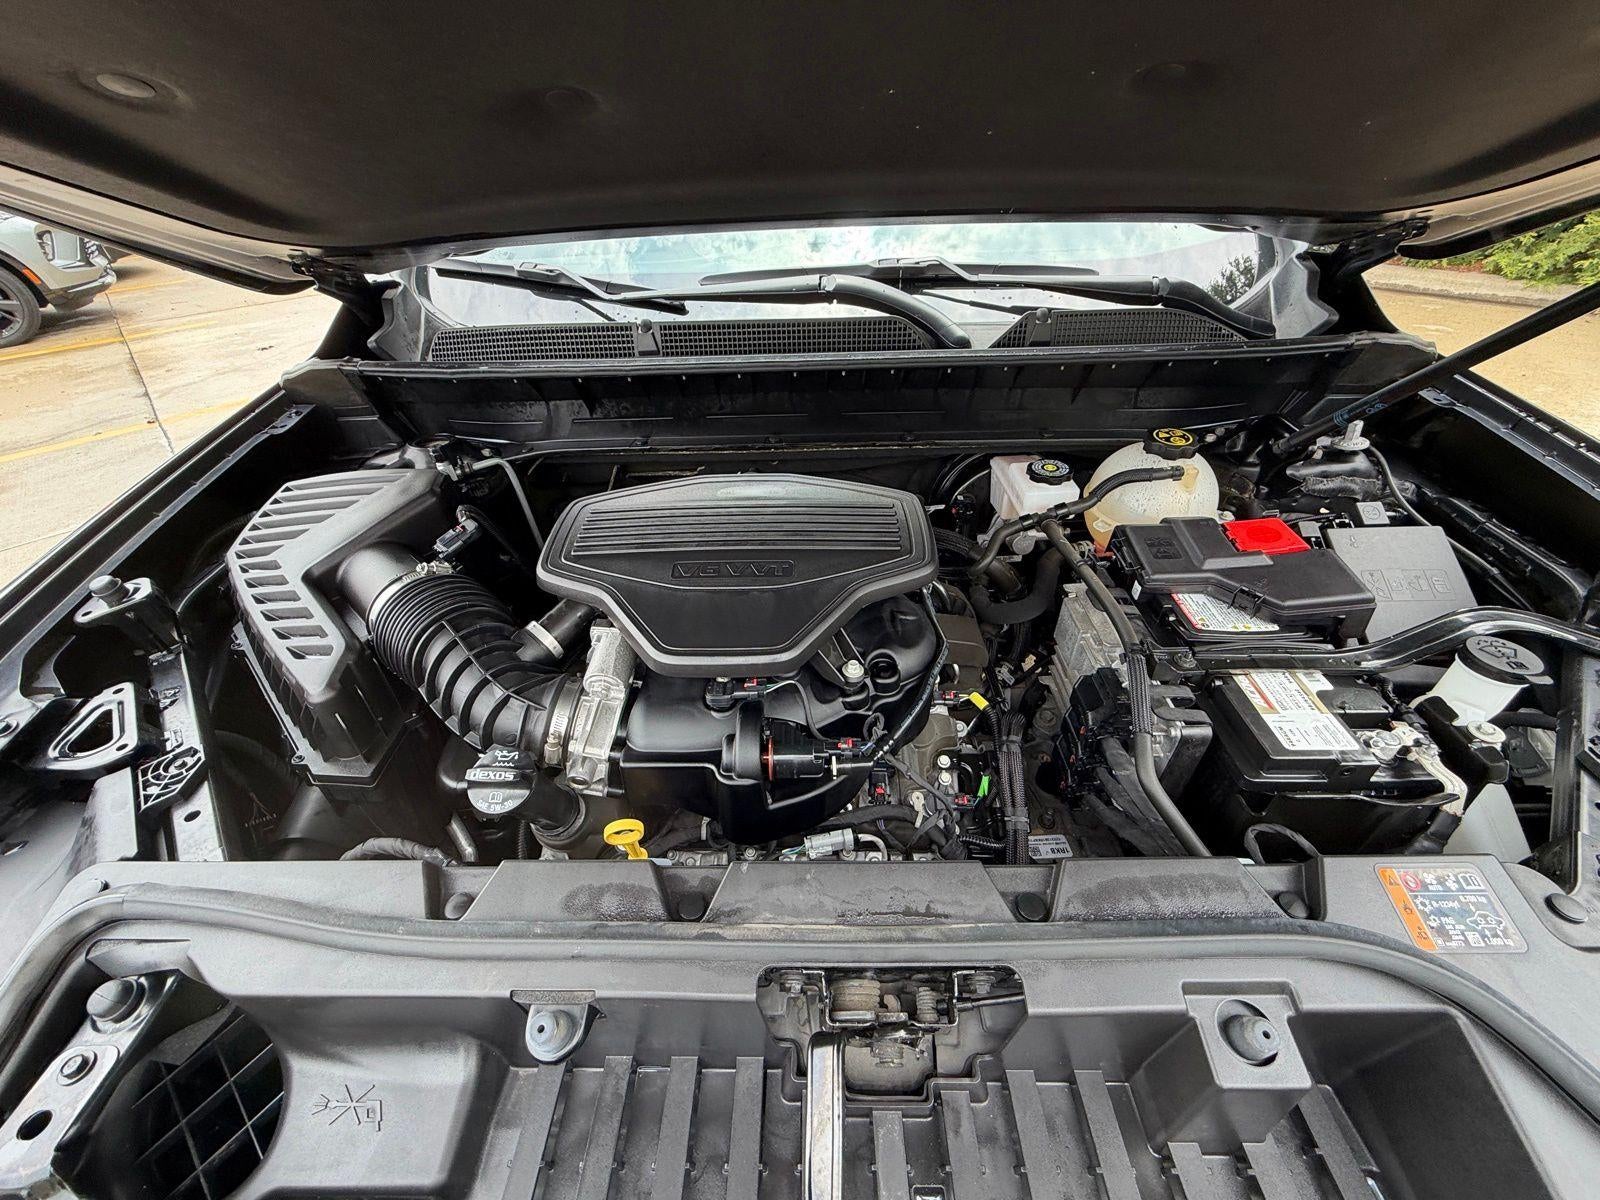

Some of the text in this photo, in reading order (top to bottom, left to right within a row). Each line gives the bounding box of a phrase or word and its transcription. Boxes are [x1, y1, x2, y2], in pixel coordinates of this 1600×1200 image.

[726, 563, 789, 575] VVT
[470, 768, 516, 780] dexos
[477, 800, 513, 811] SAE 5W-30
